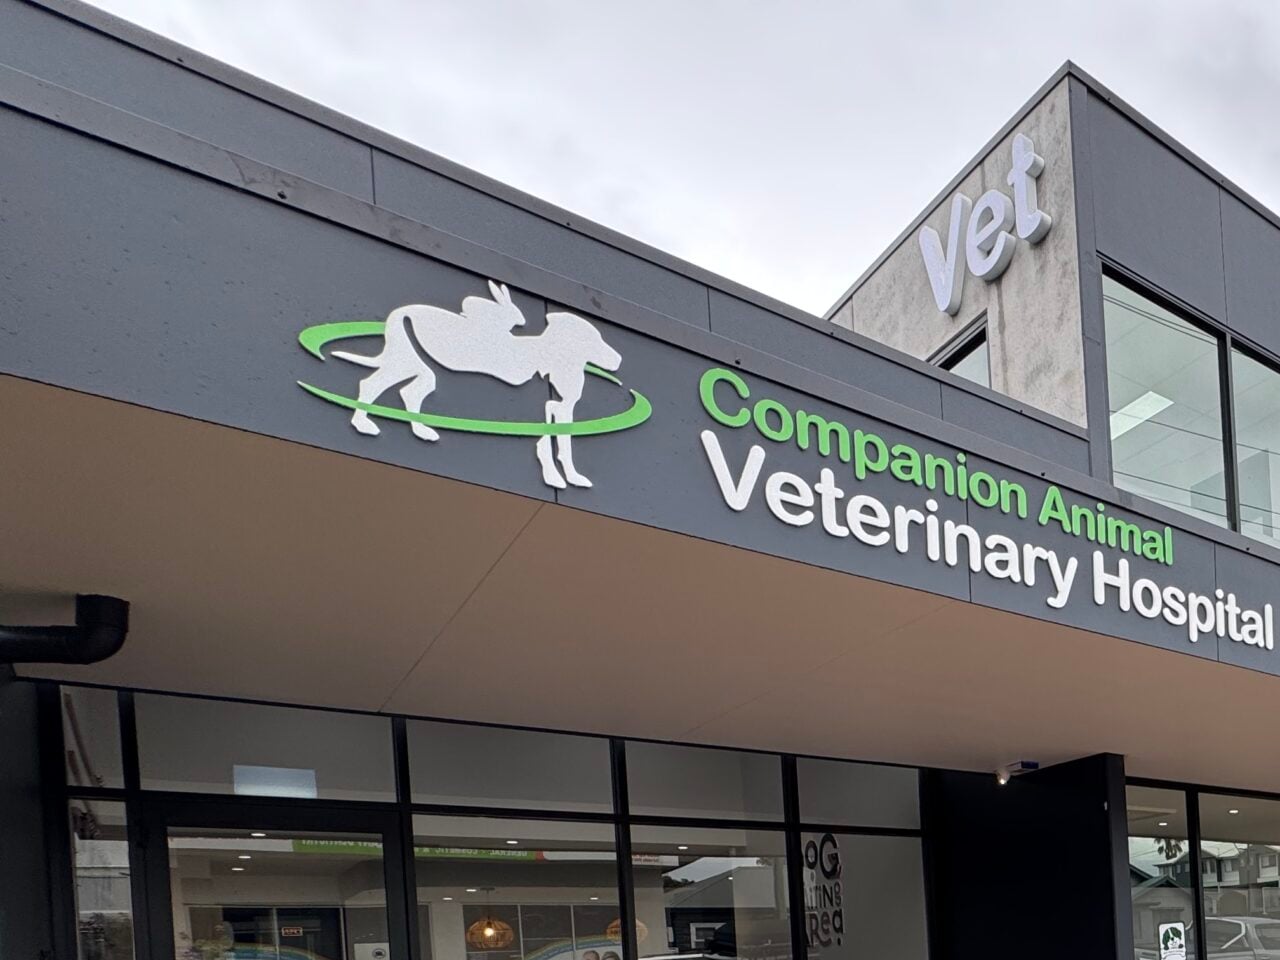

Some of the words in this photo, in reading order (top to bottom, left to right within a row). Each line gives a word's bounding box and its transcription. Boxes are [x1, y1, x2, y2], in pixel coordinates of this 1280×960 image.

[918, 132, 1053, 317] Vet
[698, 367, 1029, 519] Companion
[1039, 485, 1175, 566] Animal
[699, 429, 1079, 609] Veterinary
[1091, 550, 1275, 651] Hospital
